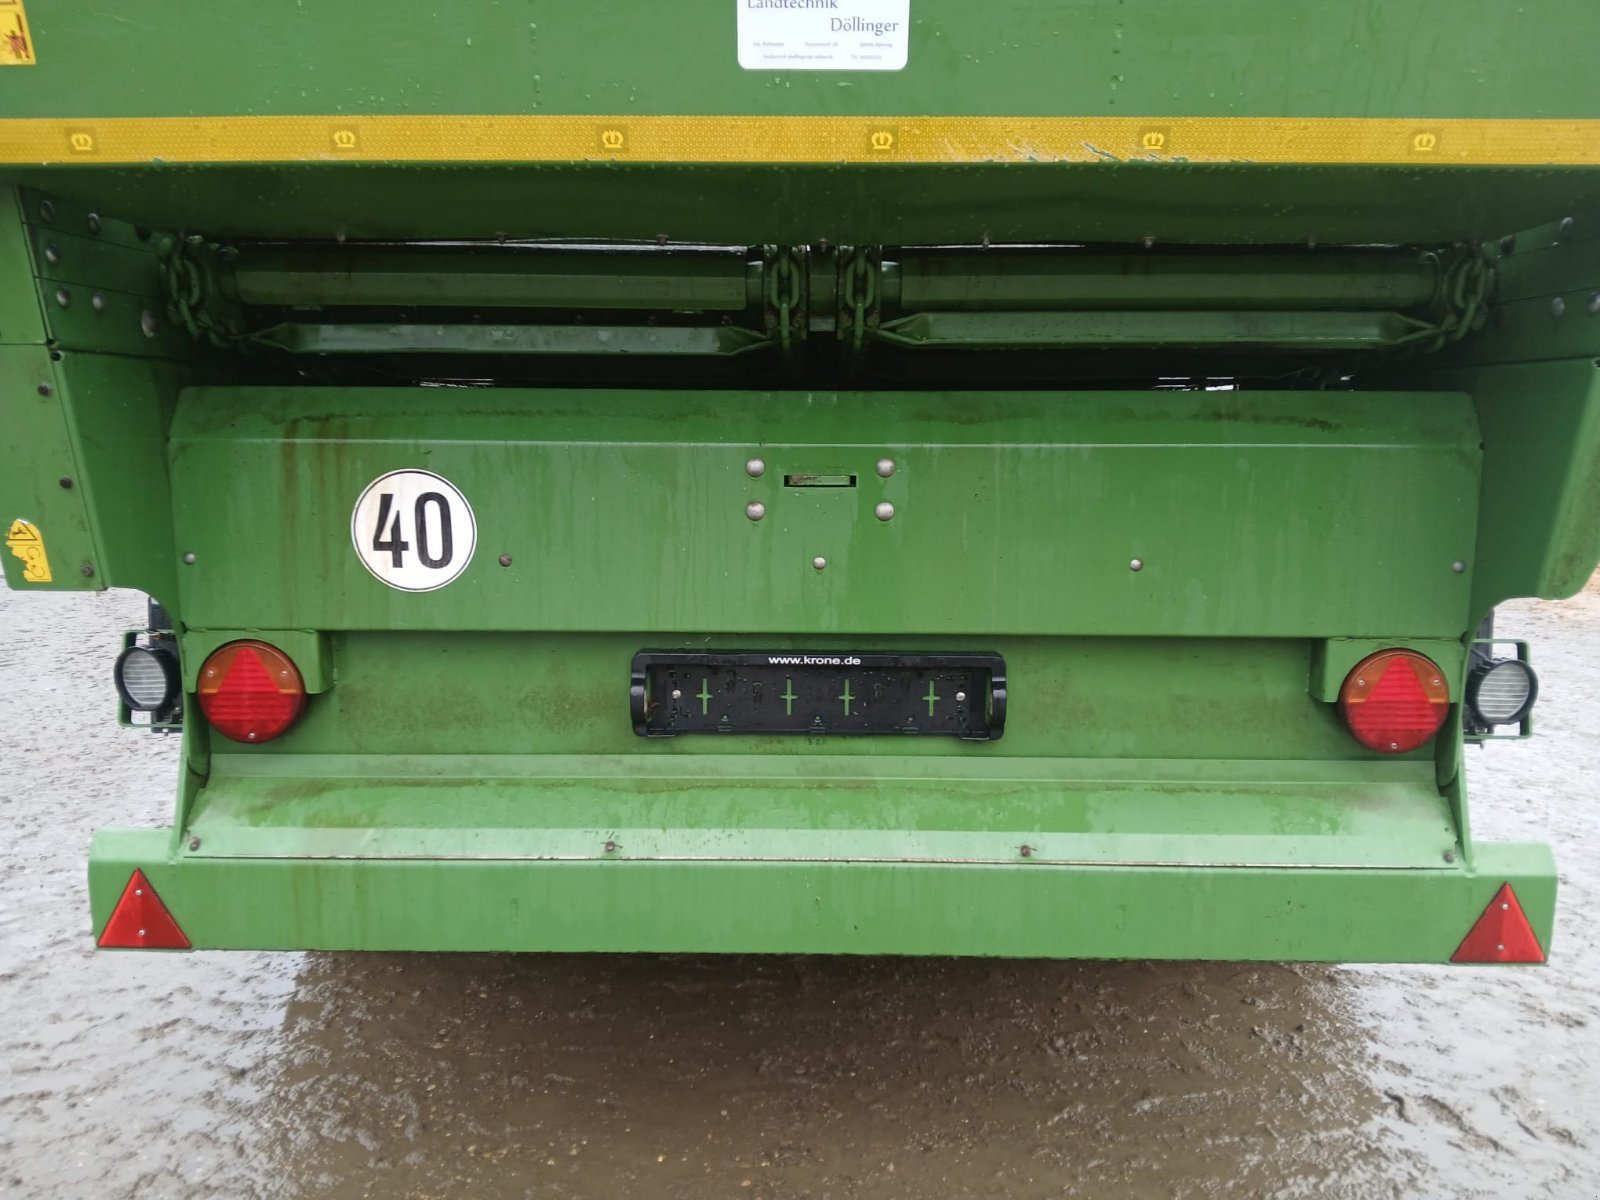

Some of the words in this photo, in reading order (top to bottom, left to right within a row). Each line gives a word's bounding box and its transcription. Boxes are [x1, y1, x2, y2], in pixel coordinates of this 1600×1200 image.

[831, 16, 899, 36] Döllinger
[373, 492, 453, 569] 40
[768, 656, 861, 665] www.krone.de
